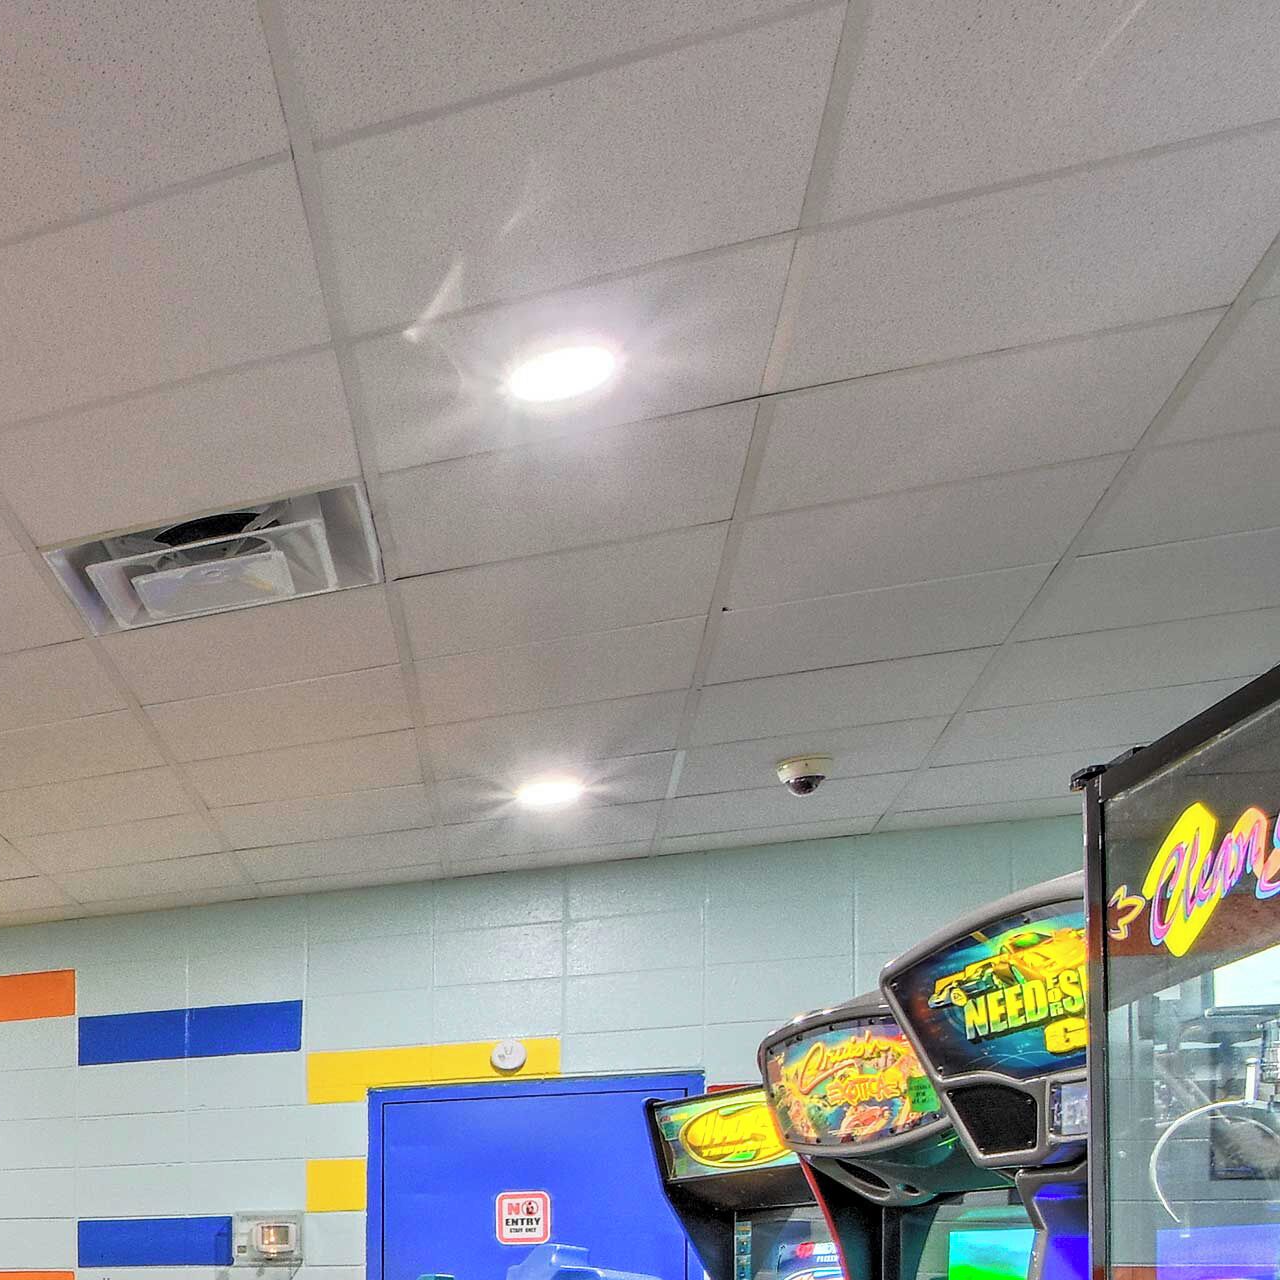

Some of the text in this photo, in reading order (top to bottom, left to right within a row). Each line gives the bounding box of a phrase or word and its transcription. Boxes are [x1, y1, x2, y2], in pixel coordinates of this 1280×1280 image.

[963, 978, 1050, 1041] NEED
[1046, 973, 1064, 1018] FOR
[505, 1217, 541, 1227] ENTRY
